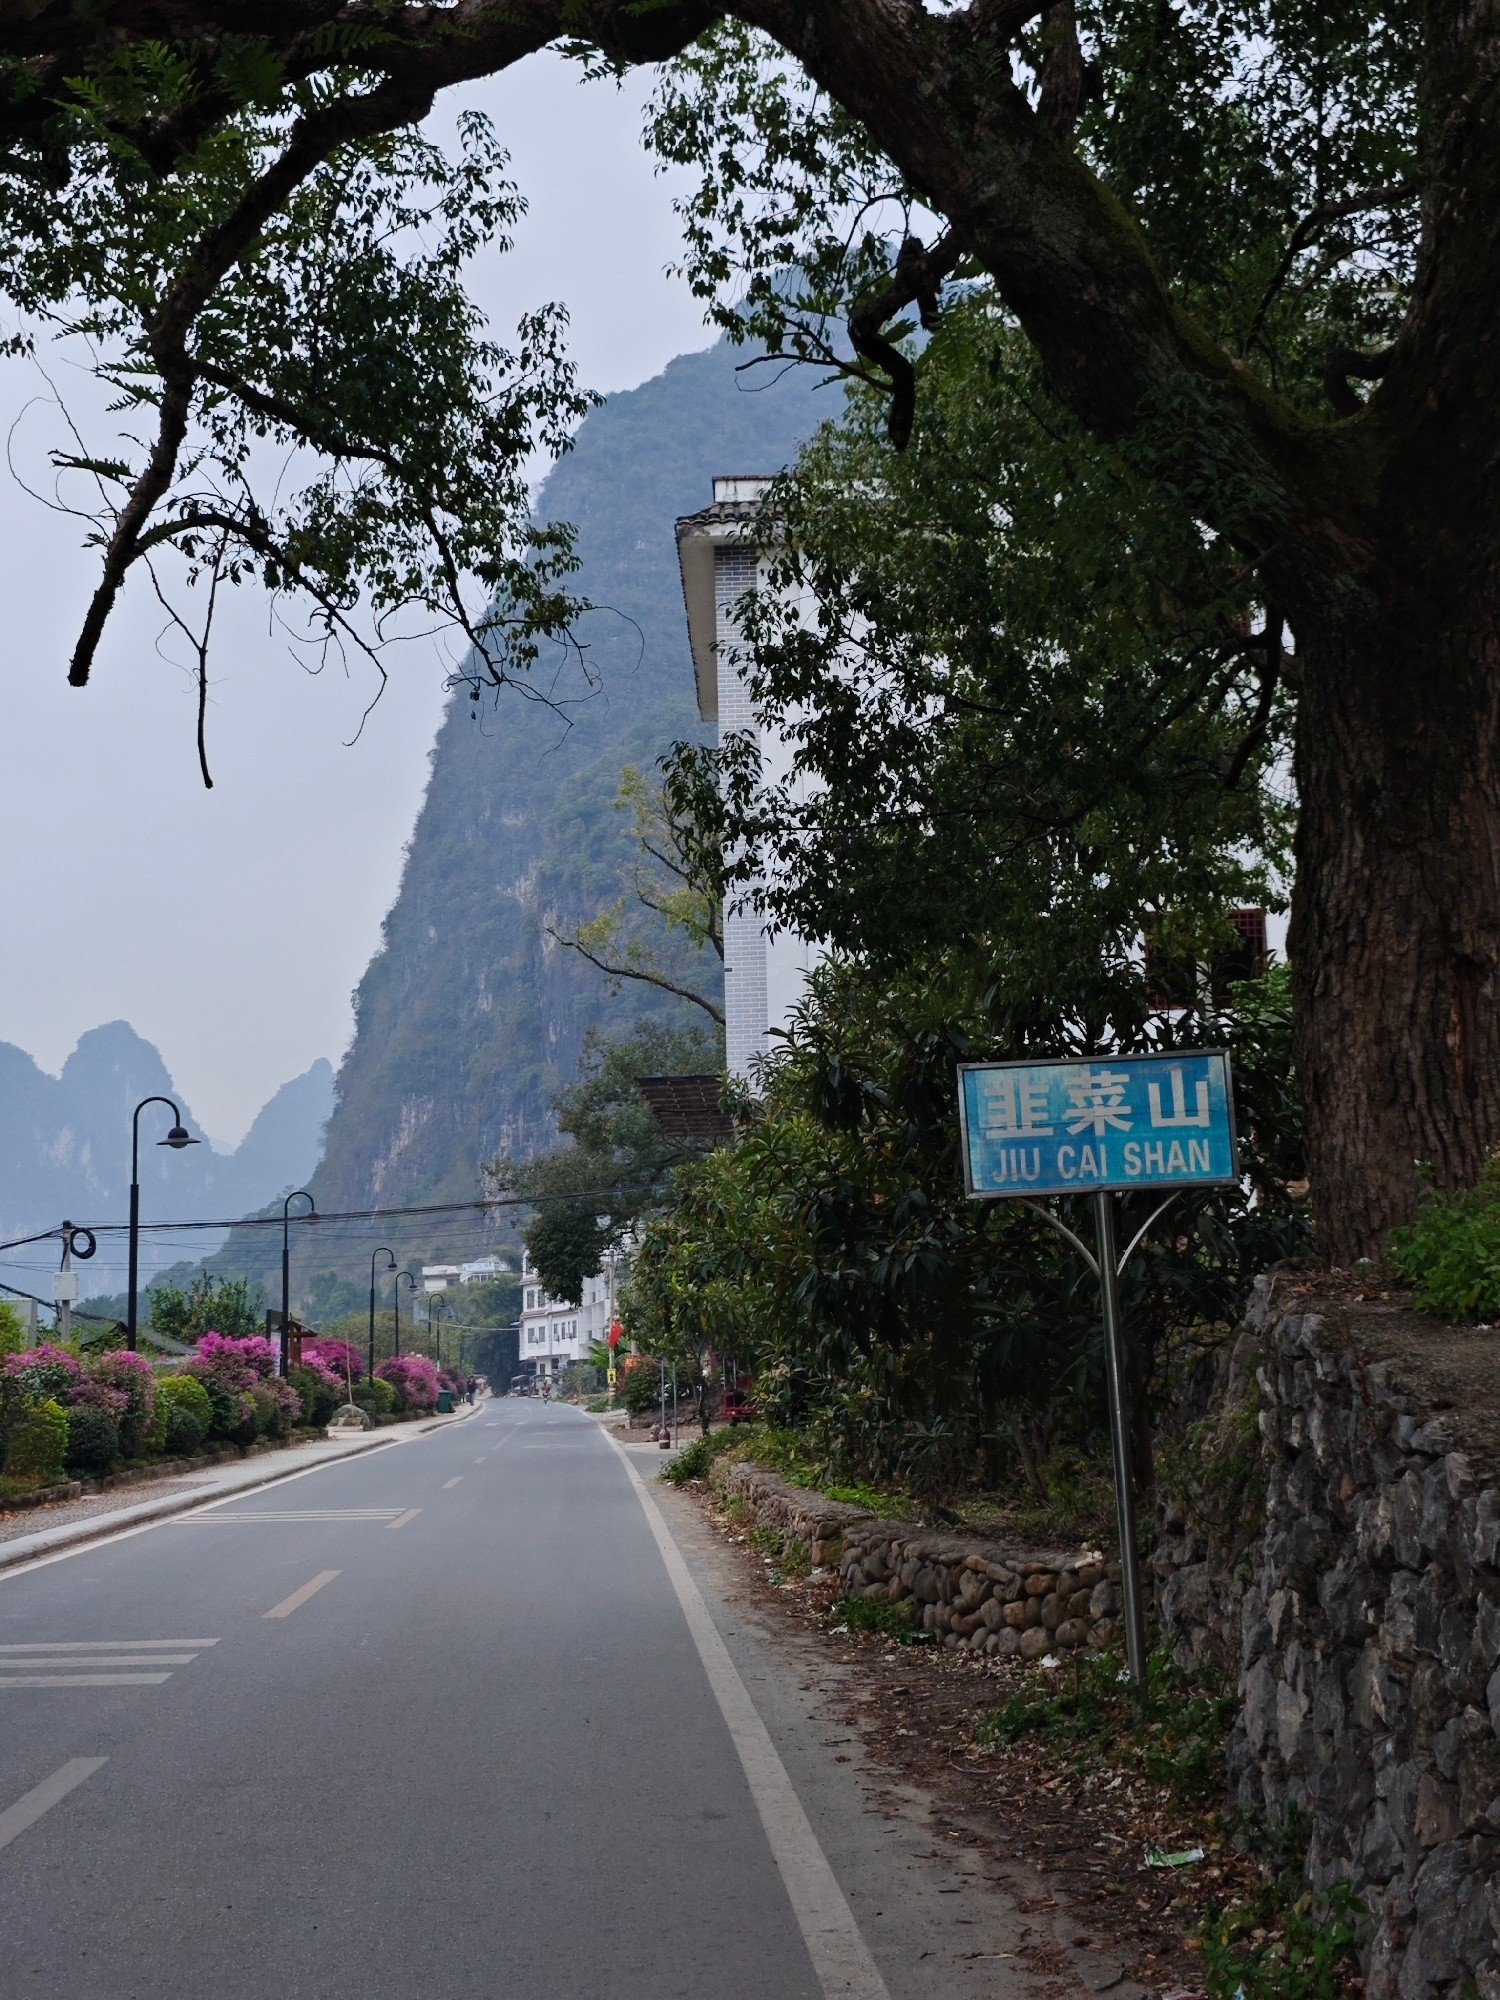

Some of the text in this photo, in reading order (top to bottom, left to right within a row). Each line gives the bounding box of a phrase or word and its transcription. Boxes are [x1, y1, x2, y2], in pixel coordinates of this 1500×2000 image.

[984, 1068, 1210, 1139] 韭菜山
[992, 1138, 1211, 1182] JIU CAI SHAN
